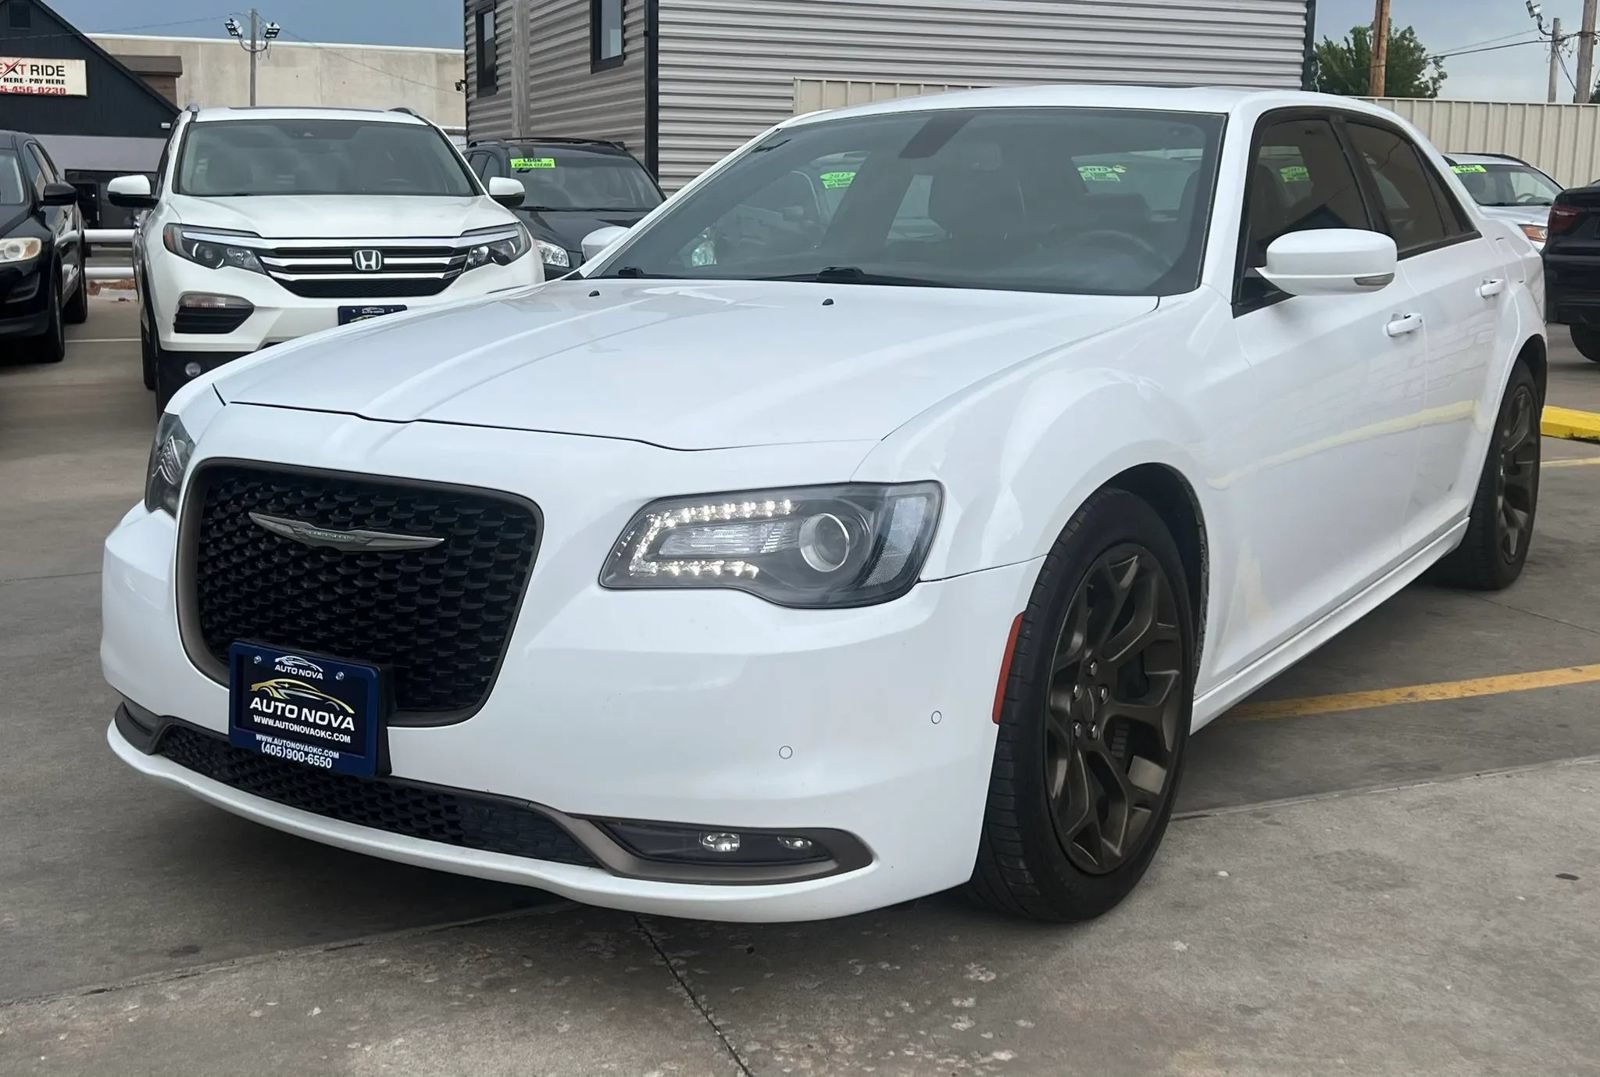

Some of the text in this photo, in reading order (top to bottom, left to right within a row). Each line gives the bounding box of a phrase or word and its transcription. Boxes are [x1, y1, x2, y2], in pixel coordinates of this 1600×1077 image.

[30, 64, 65, 77] RIDE
[274, 664, 324, 680] AUTO NOVA
[249, 697, 355, 731] AUTO NOVA
[253, 714, 351, 743] WWW.AUTONOVAOKC.COM
[255, 734, 340, 759] WWW.AUTONOVAOKC.COM
[261, 741, 333, 769] (405)900-6550
